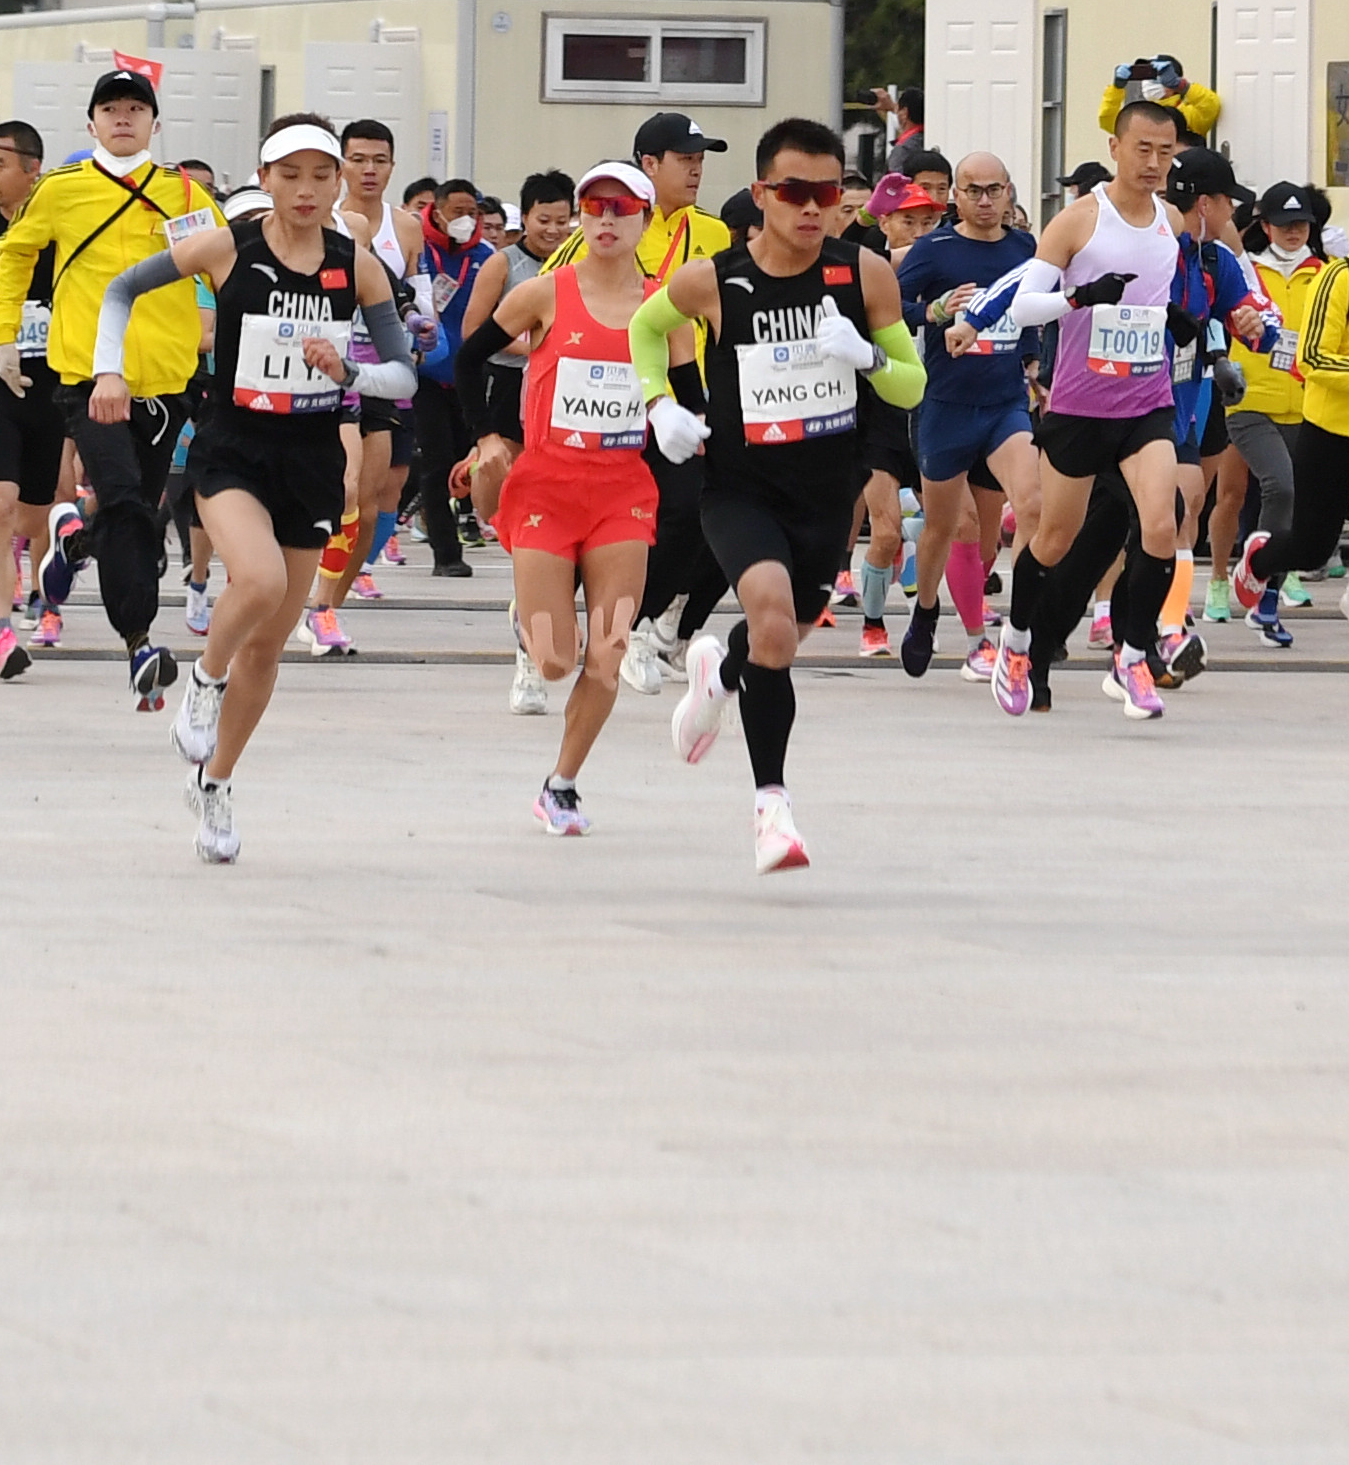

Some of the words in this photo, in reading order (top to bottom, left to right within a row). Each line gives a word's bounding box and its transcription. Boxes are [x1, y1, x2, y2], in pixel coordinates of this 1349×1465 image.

[267, 290, 334, 323] CHINA
[752, 303, 827, 344] CHINA
[1098, 328, 1160, 356] T0019
[263, 354, 291, 380] LI
[562, 395, 622, 419] YANG
[625, 400, 642, 418] H.
[752, 384, 808, 407] YANG
[813, 379, 847, 399] CH.
